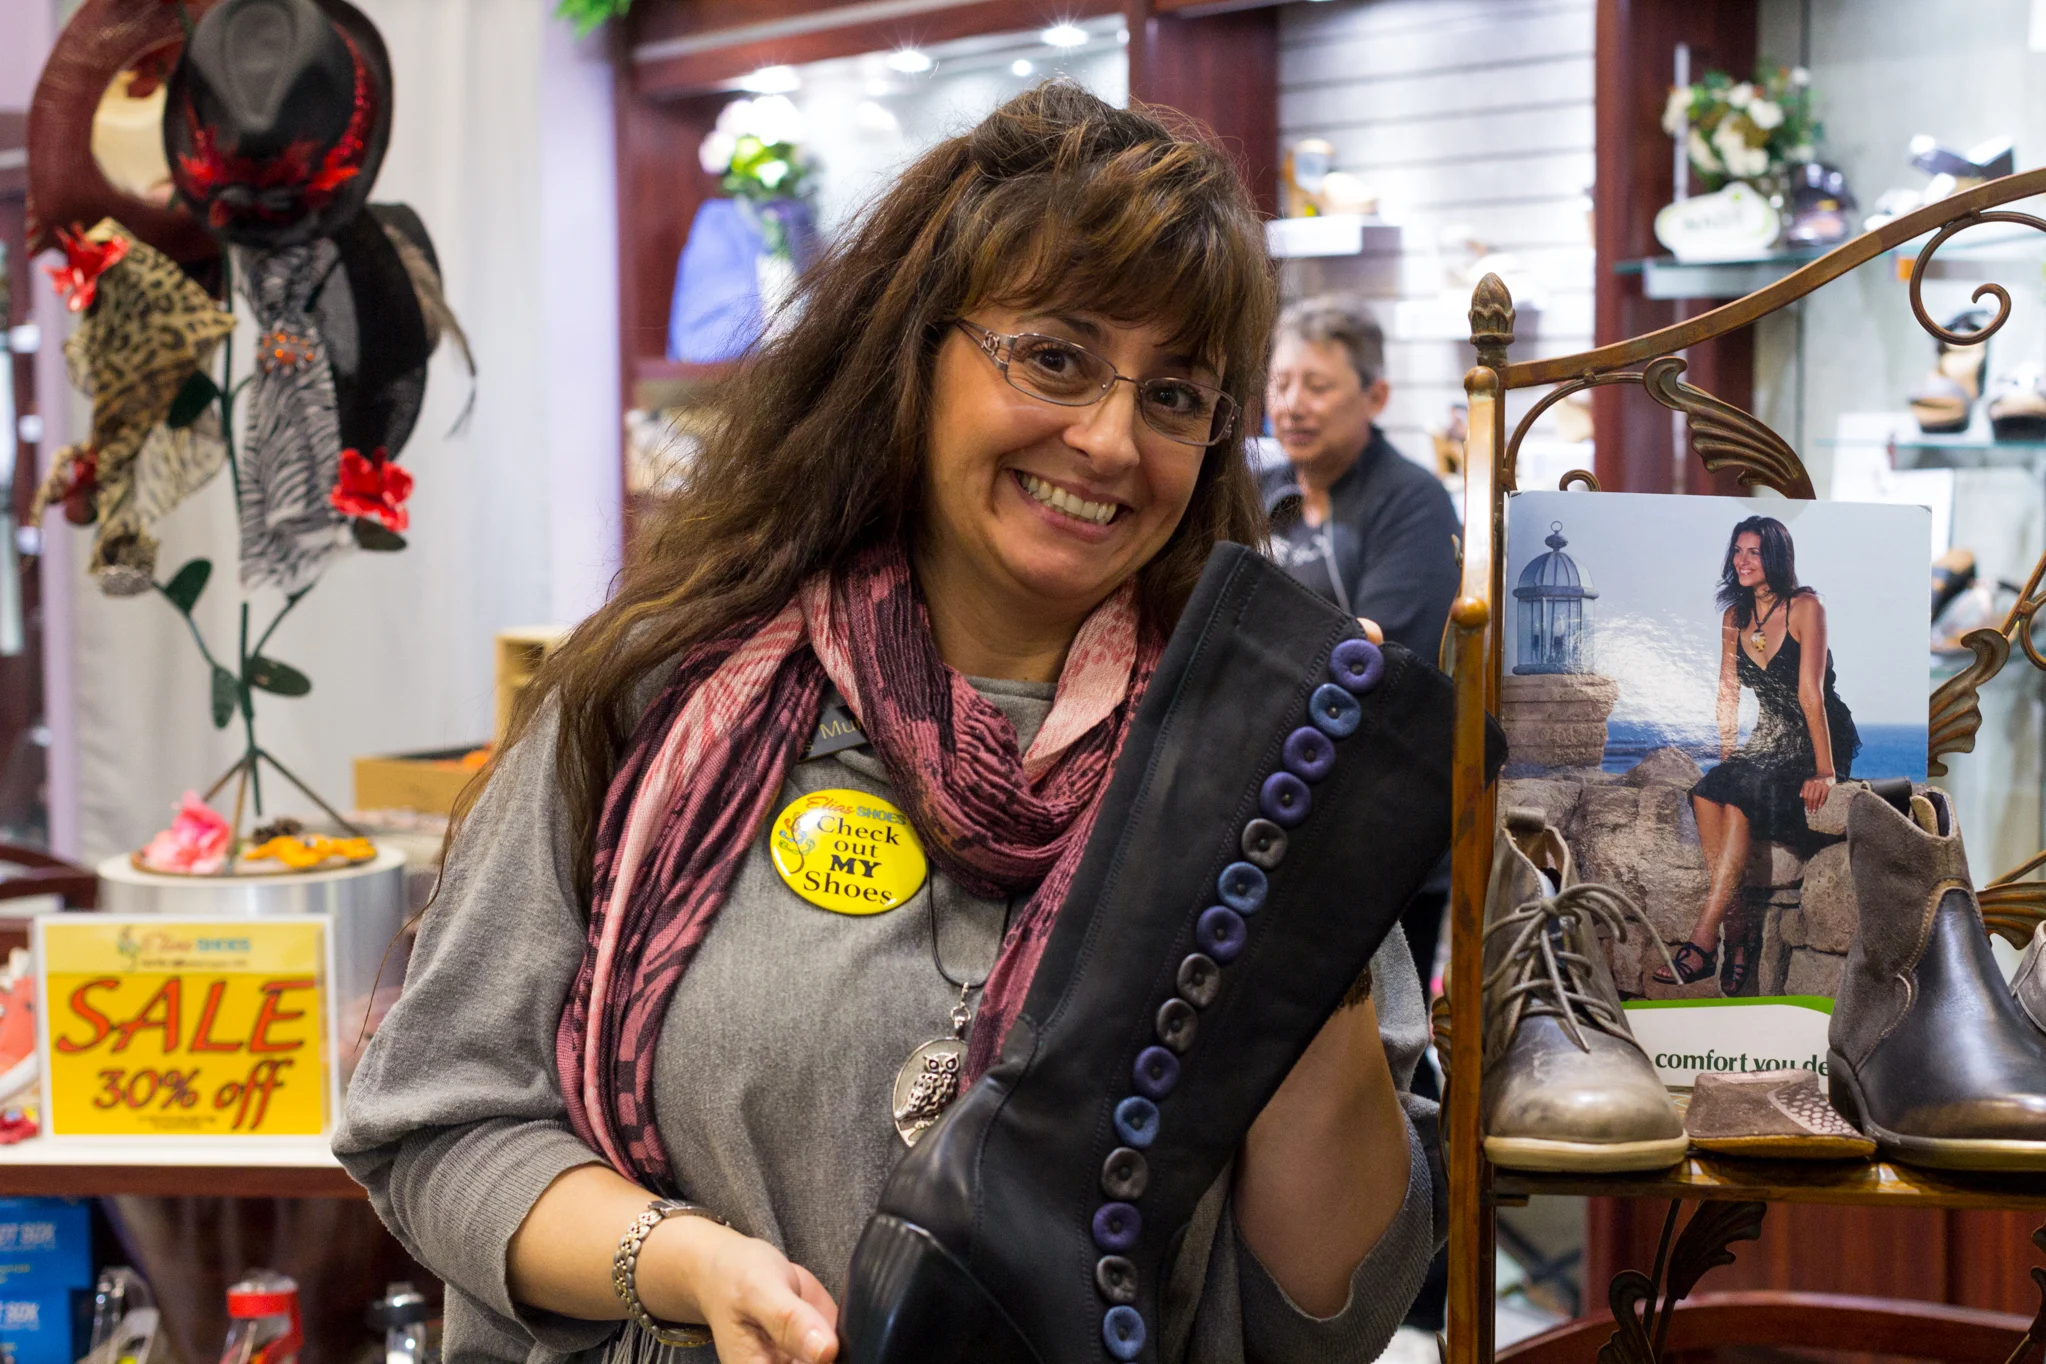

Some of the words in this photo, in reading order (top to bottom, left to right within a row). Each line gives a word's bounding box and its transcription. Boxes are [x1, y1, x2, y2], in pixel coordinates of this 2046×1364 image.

[819, 719, 860, 740] Mu
[805, 796, 855, 815] Elias
[856, 806, 907, 825] SHOES
[816, 815, 901, 846] Check
[833, 839, 880, 859] out
[829, 854, 883, 879] MY
[803, 871, 893, 906] Shoes
[56, 976, 319, 1054] SALE
[1655, 1048, 1748, 1073] comfort
[93, 1066, 201, 1111] 30%
[214, 1058, 295, 1131] off
